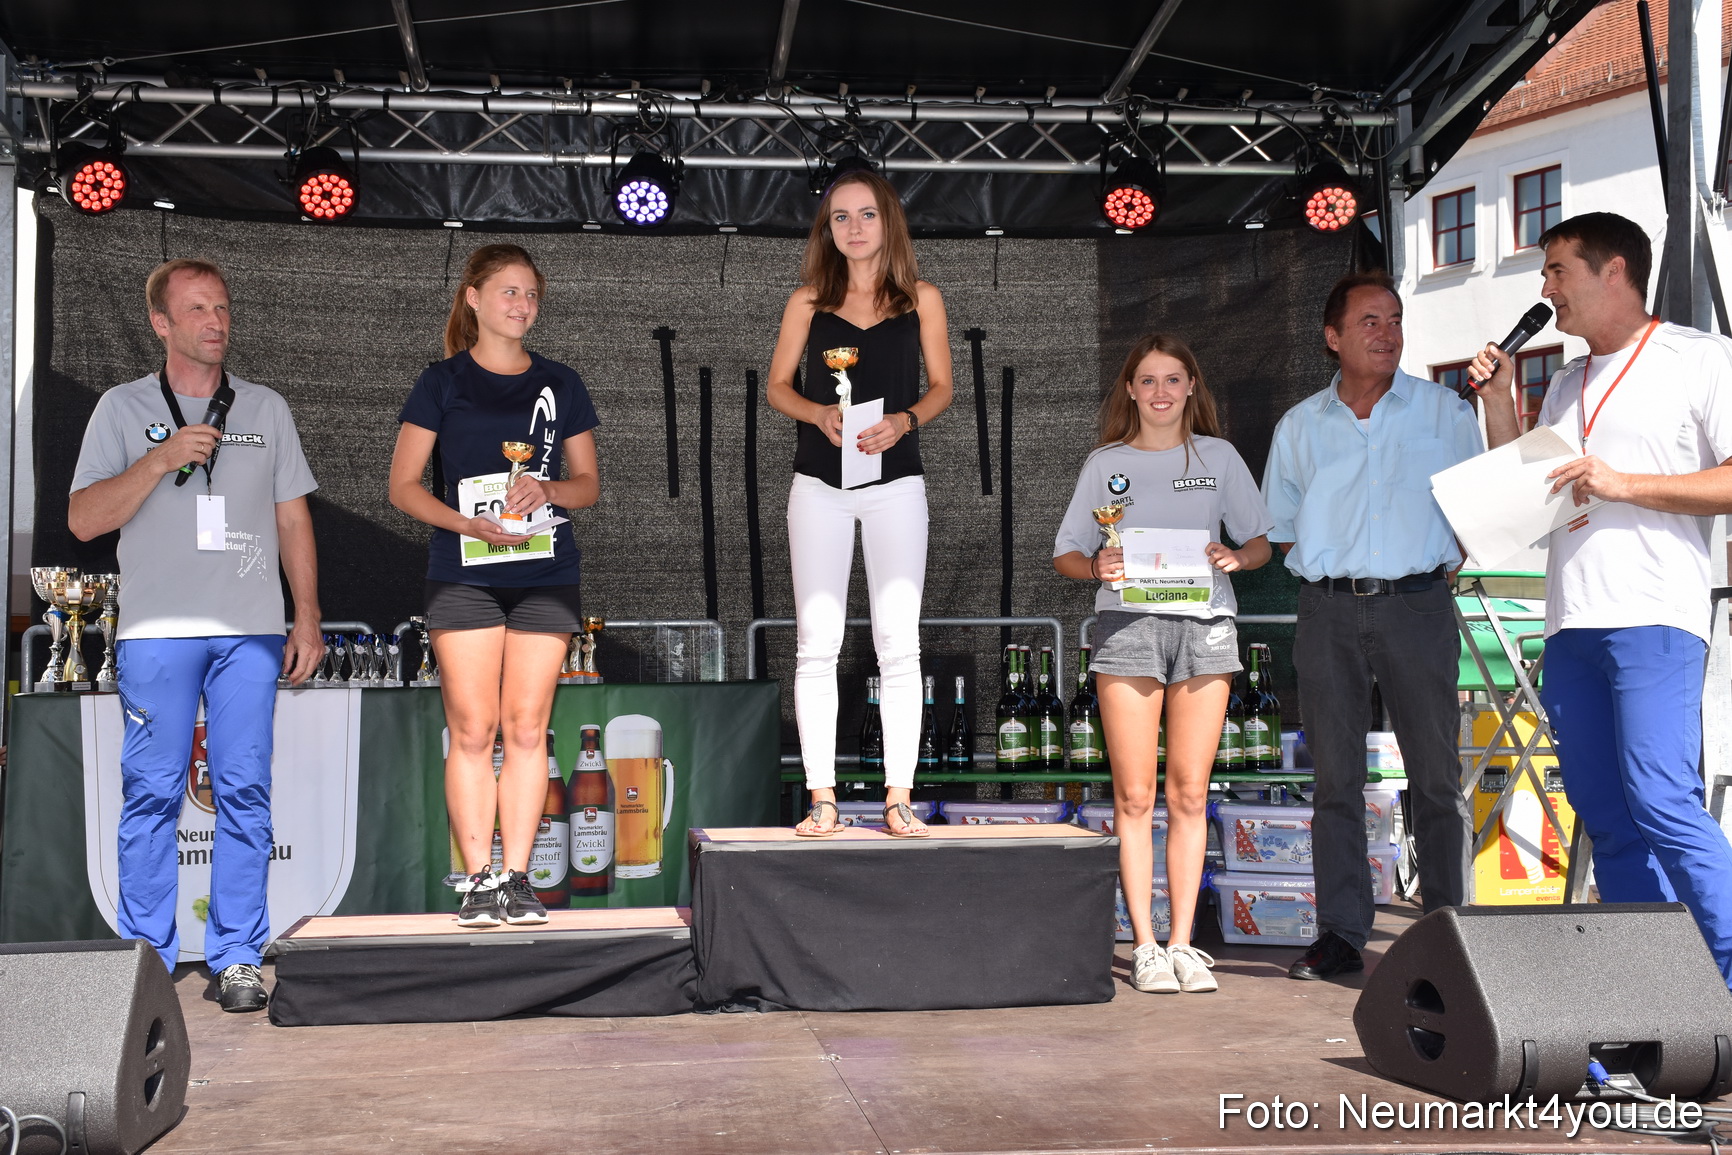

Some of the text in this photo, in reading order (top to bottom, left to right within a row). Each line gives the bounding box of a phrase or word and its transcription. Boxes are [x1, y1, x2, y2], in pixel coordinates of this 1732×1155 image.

[220, 432, 265, 445] BOCK
[1173, 477, 1216, 489] BOCK
[1111, 496, 1133, 505] PARTL
[225, 531, 253, 540] markter
[225, 542, 246, 553] tlauf
[1146, 590, 1188, 601] Luciana
[576, 839, 605, 848] Zwickl
[529, 852, 561, 861] Urstoff
